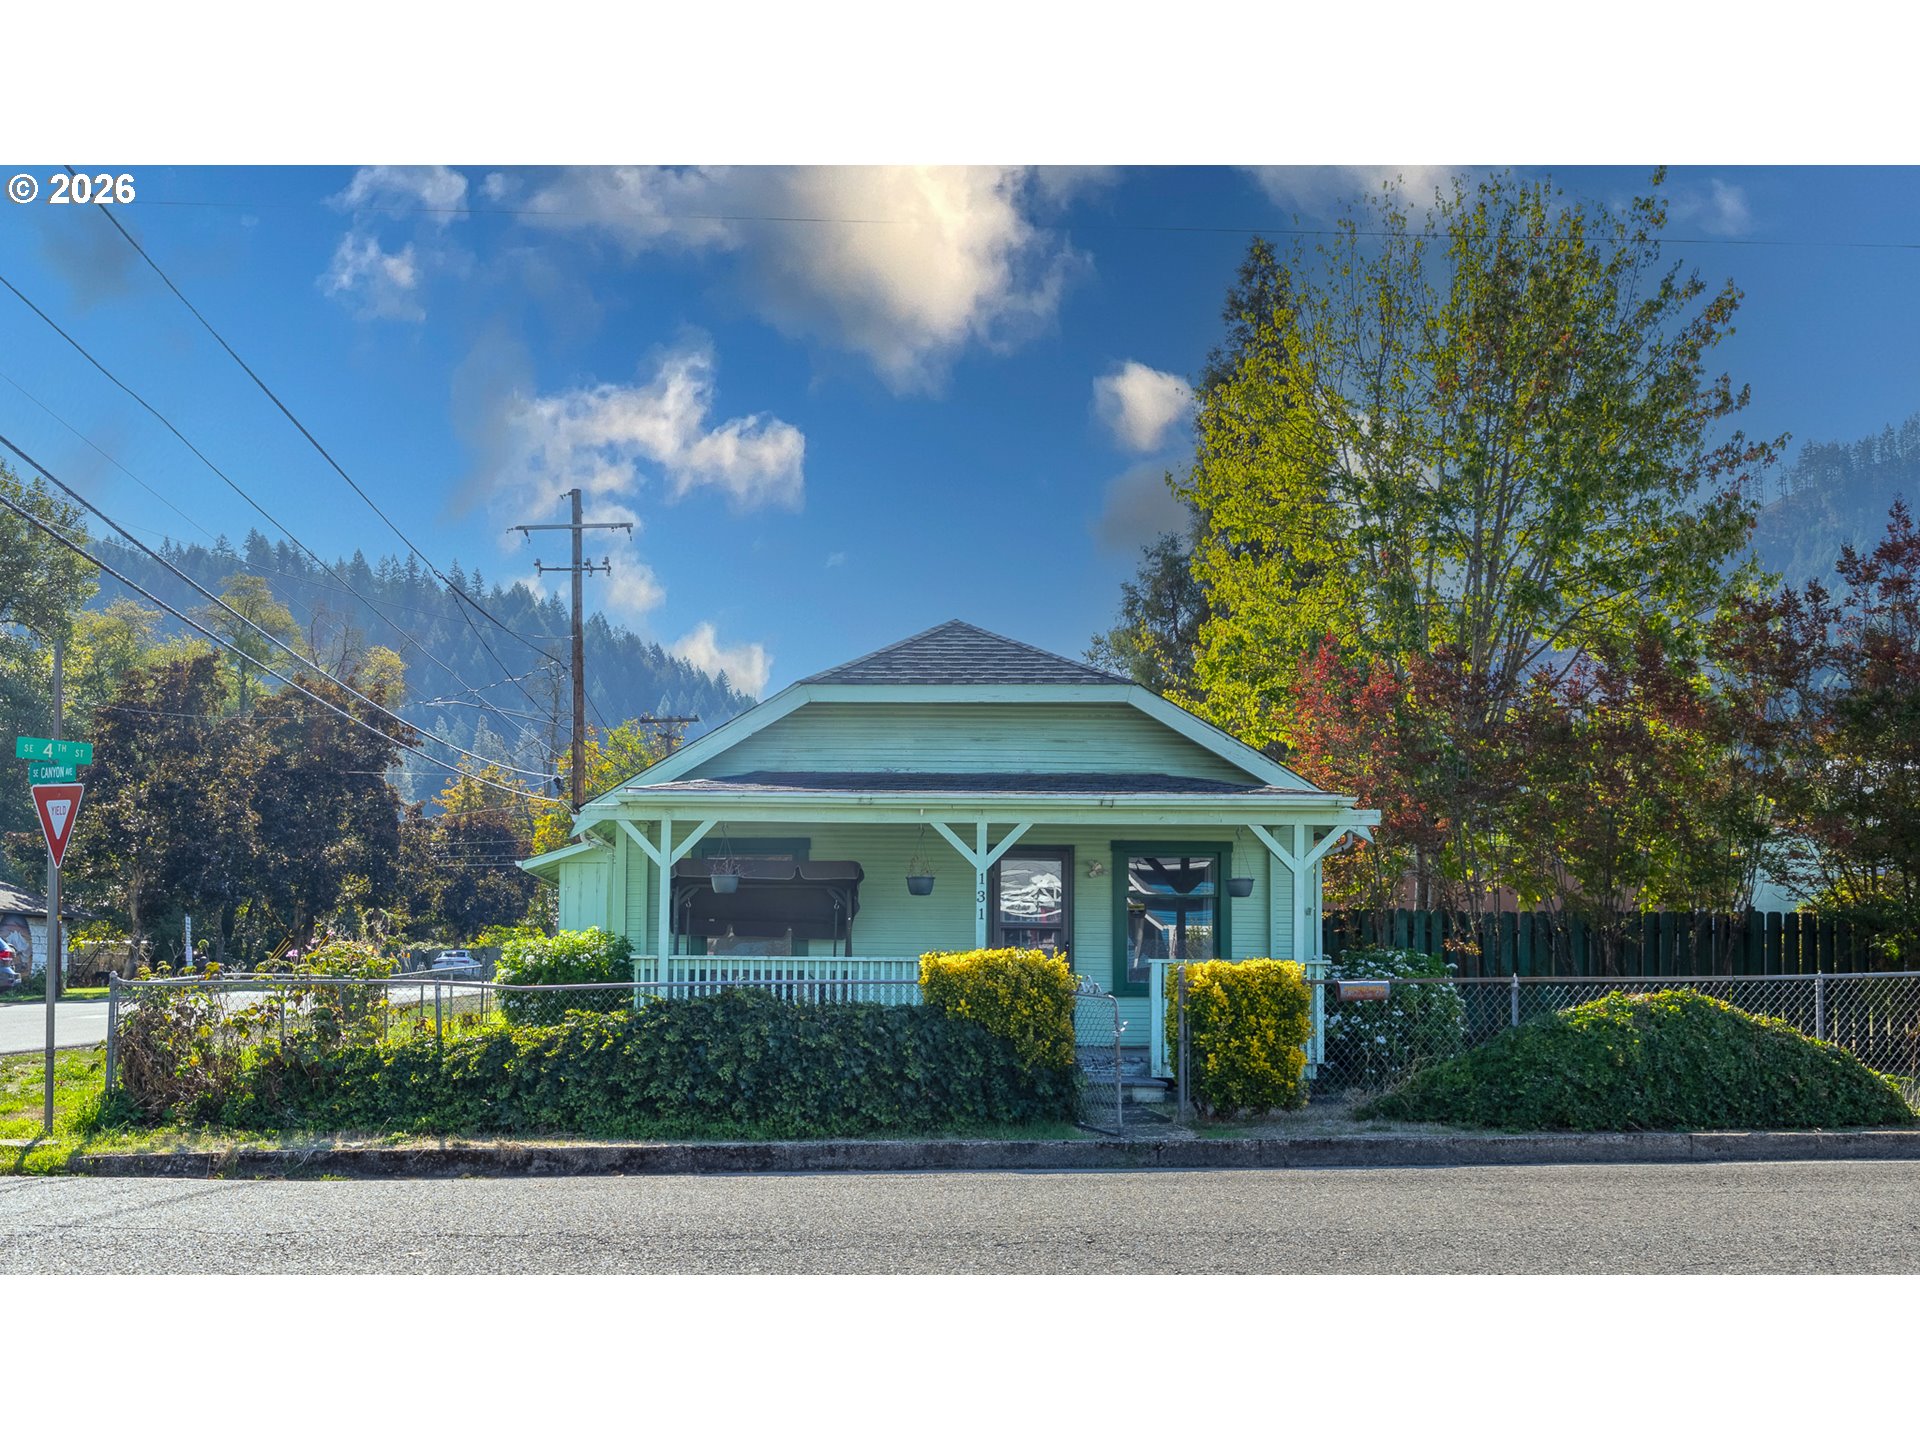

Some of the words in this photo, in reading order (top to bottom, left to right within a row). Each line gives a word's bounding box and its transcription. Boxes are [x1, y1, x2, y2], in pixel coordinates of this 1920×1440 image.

[23, 743, 34, 753] SE
[74, 749, 84, 758] ST
[32, 768, 39, 778] SE
[40, 766, 65, 779] CANYON
[65, 768, 73, 776] AVE
[51, 805, 67, 816] YIELD
[976, 872, 986, 920] 131
